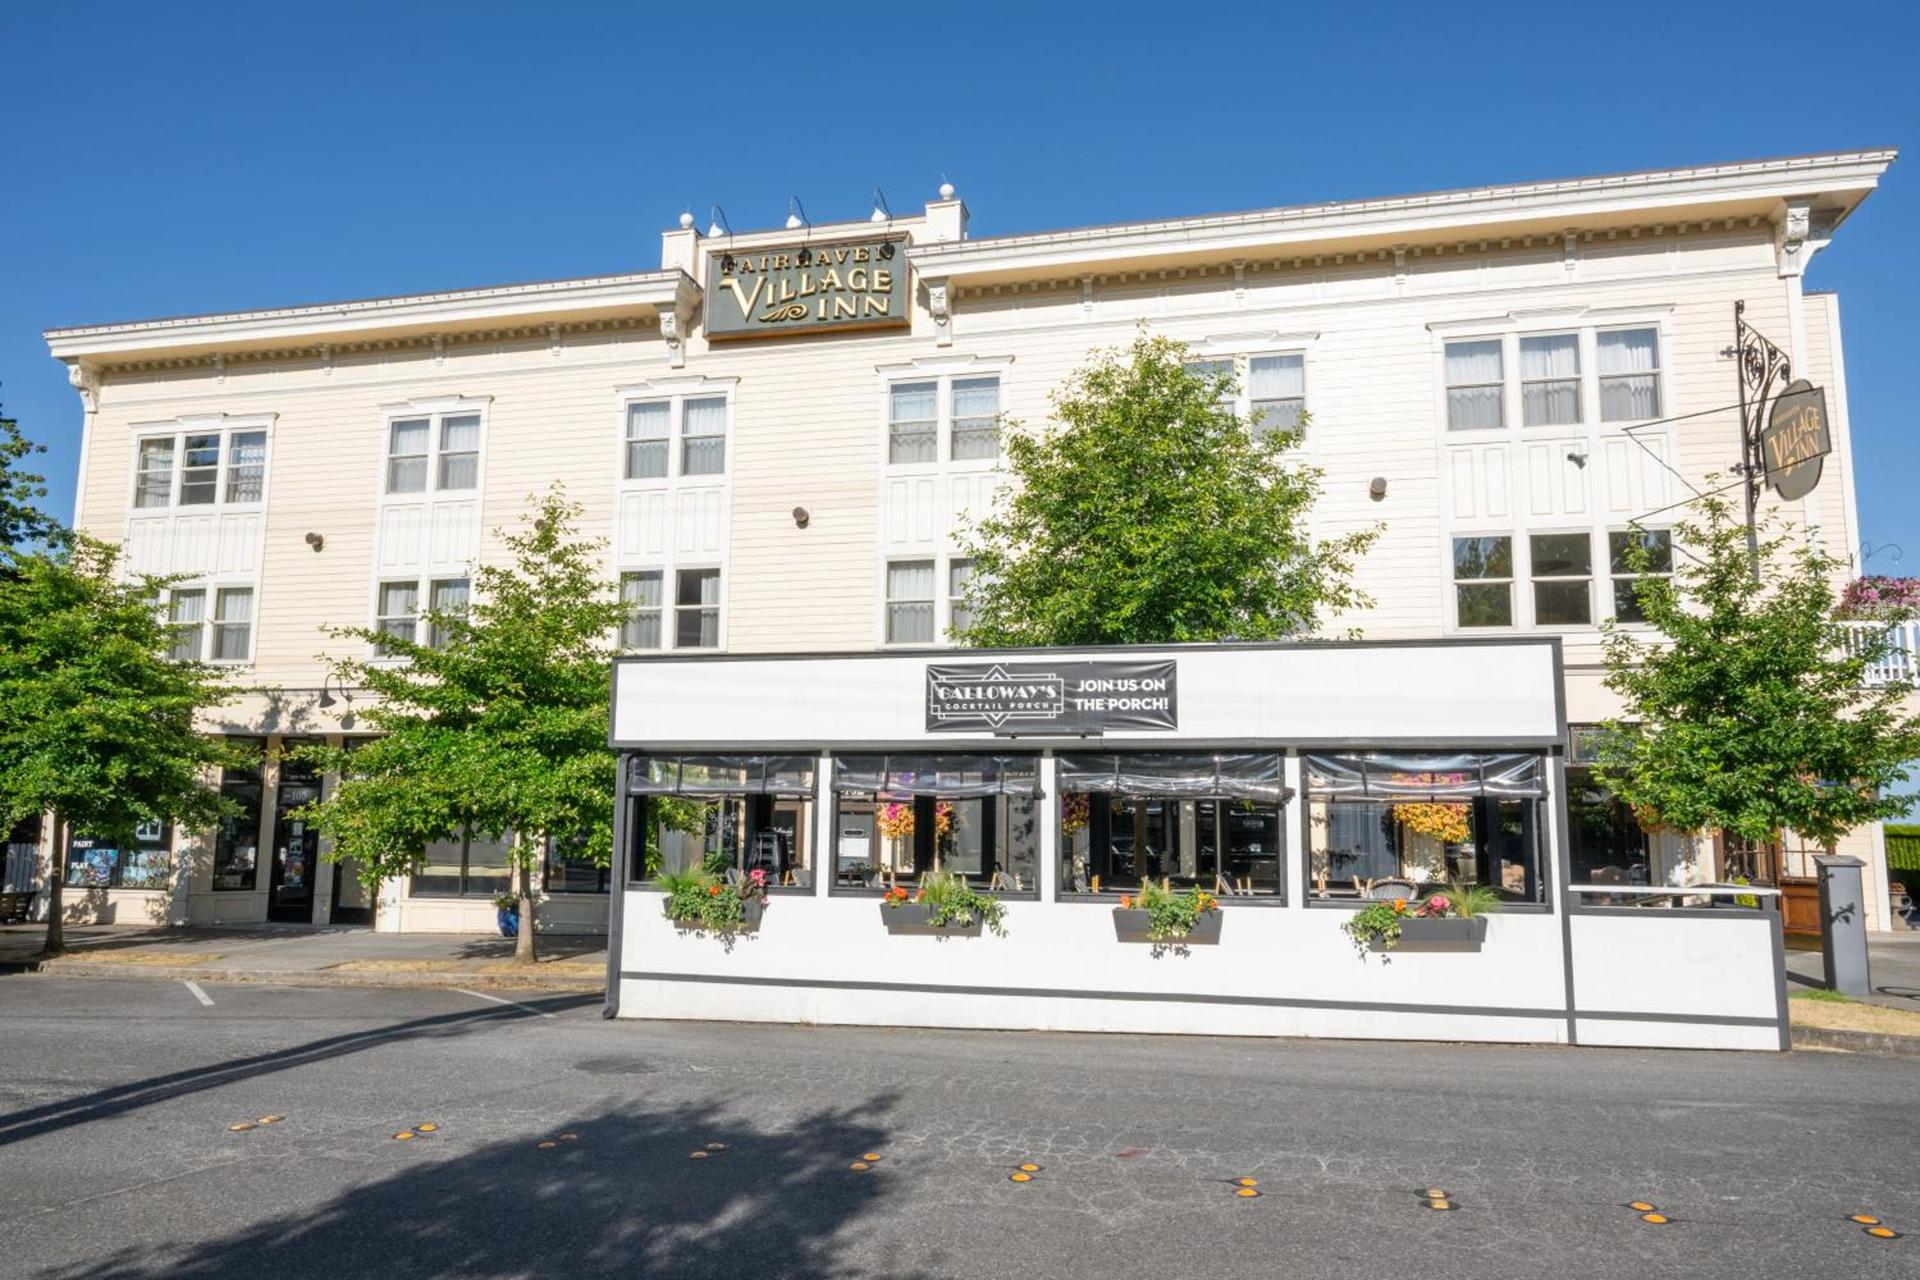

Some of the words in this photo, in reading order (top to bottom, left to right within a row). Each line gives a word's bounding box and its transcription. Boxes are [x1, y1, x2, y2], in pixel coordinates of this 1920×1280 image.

[719, 268, 893, 322] VILLAGE
[817, 295, 890, 321] INN
[1769, 406, 1821, 468] VILLAGE
[1796, 431, 1820, 469] INN
[939, 685, 1057, 700] GALLOWAY'S
[1076, 679, 1113, 692] JOIN
[1117, 679, 1138, 691] US
[1141, 678, 1166, 691] ON
[1075, 698, 1106, 711] THE
[1108, 697, 1169, 710] PORCH!
[72, 840, 94, 848] PAINT
